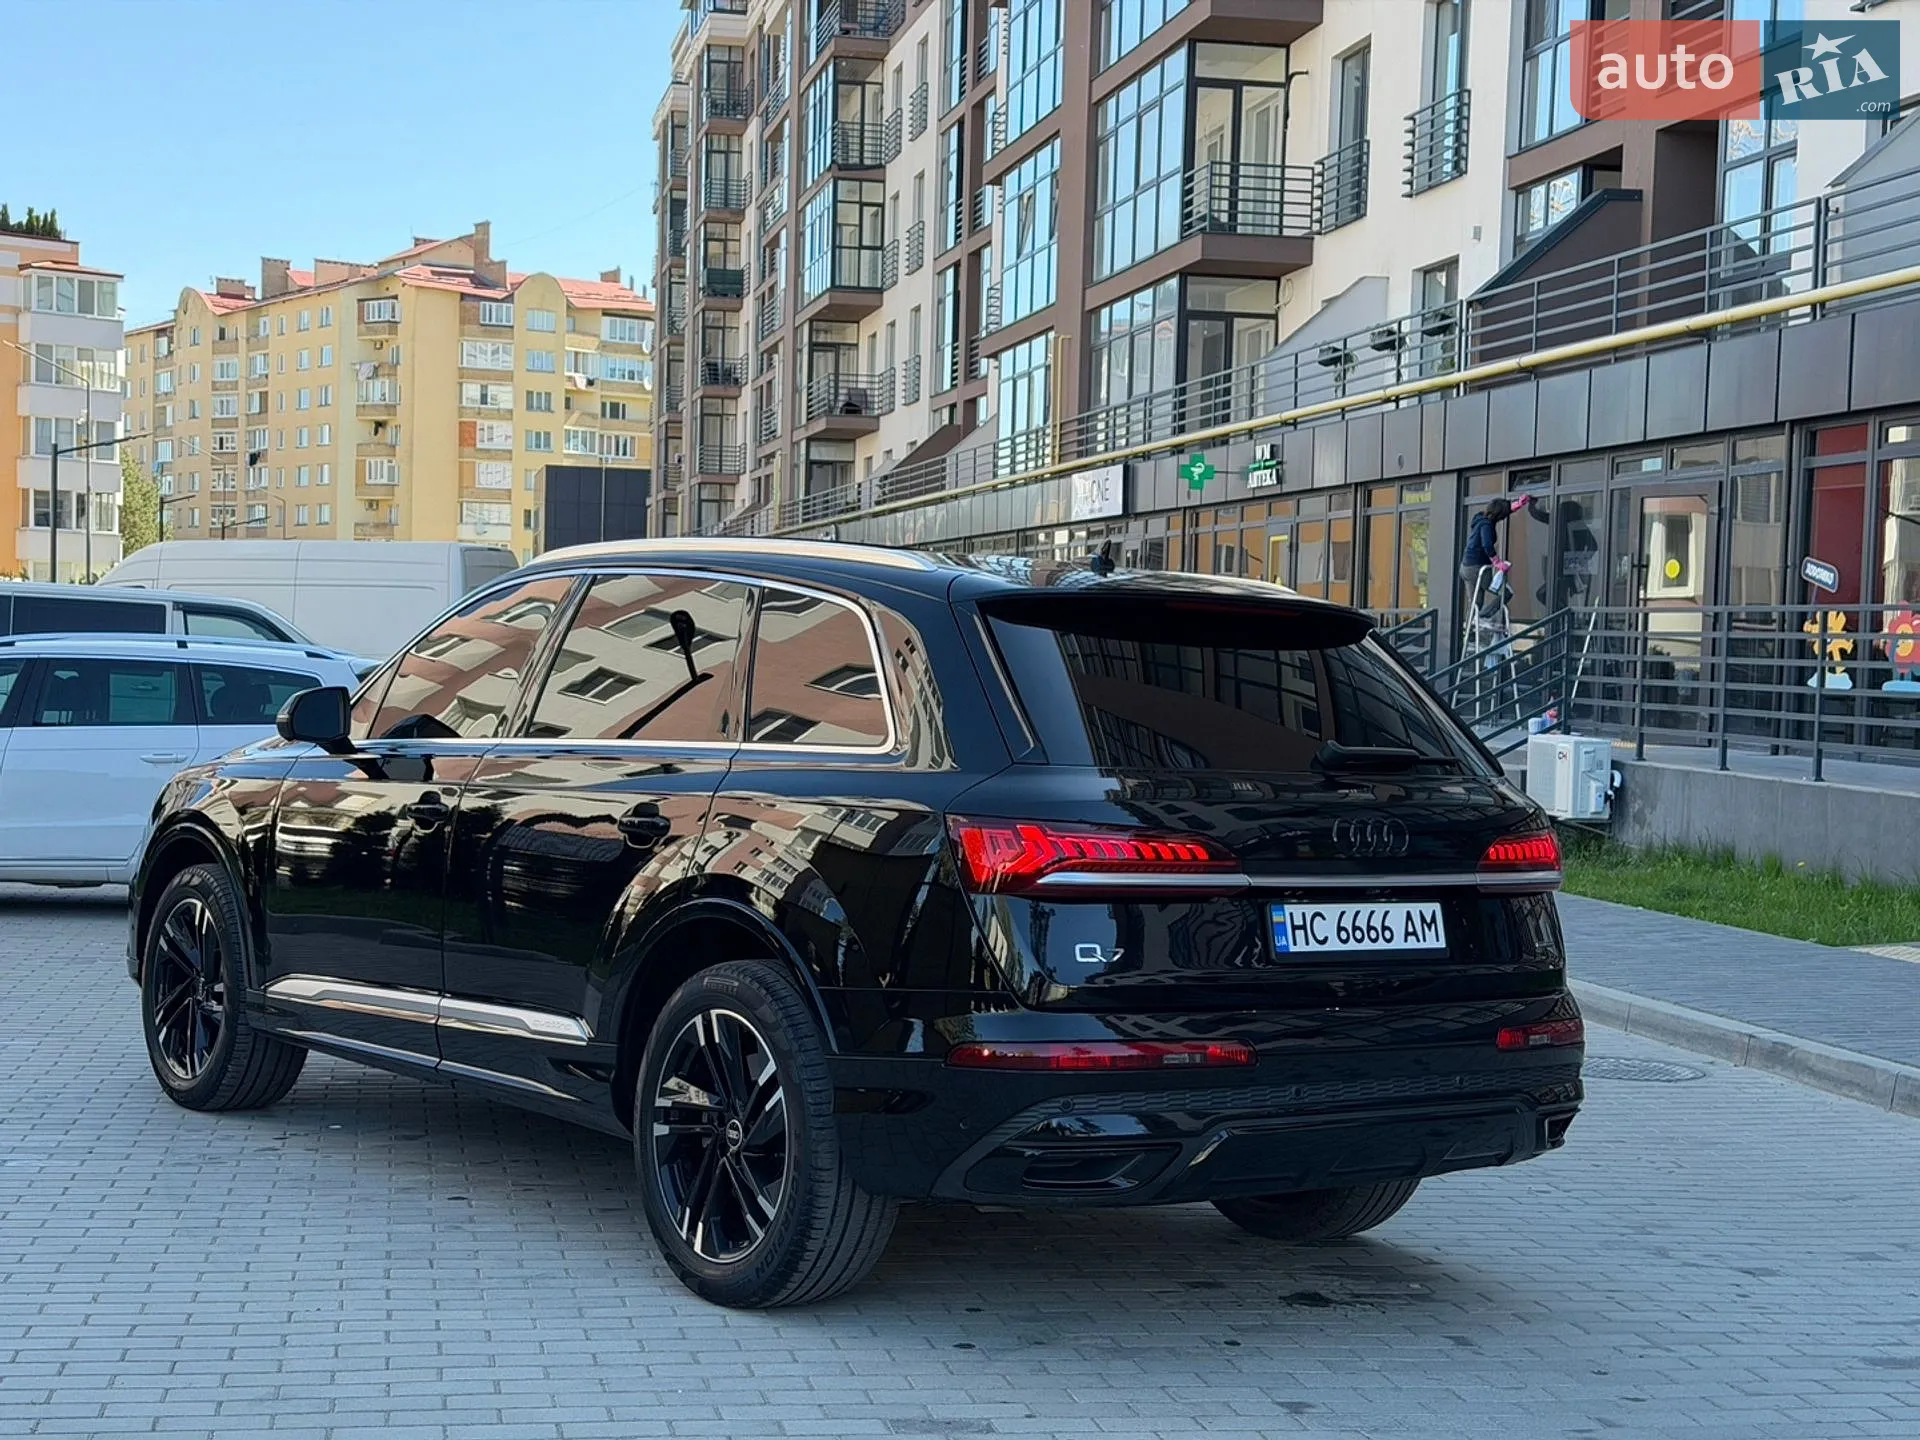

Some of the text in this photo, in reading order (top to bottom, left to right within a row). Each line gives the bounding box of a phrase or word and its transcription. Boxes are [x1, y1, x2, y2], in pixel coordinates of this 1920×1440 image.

[1289, 909, 1440, 946] HC 6666 AM
[1274, 936, 1288, 947] UA
[1075, 943, 1124, 962] Q7
